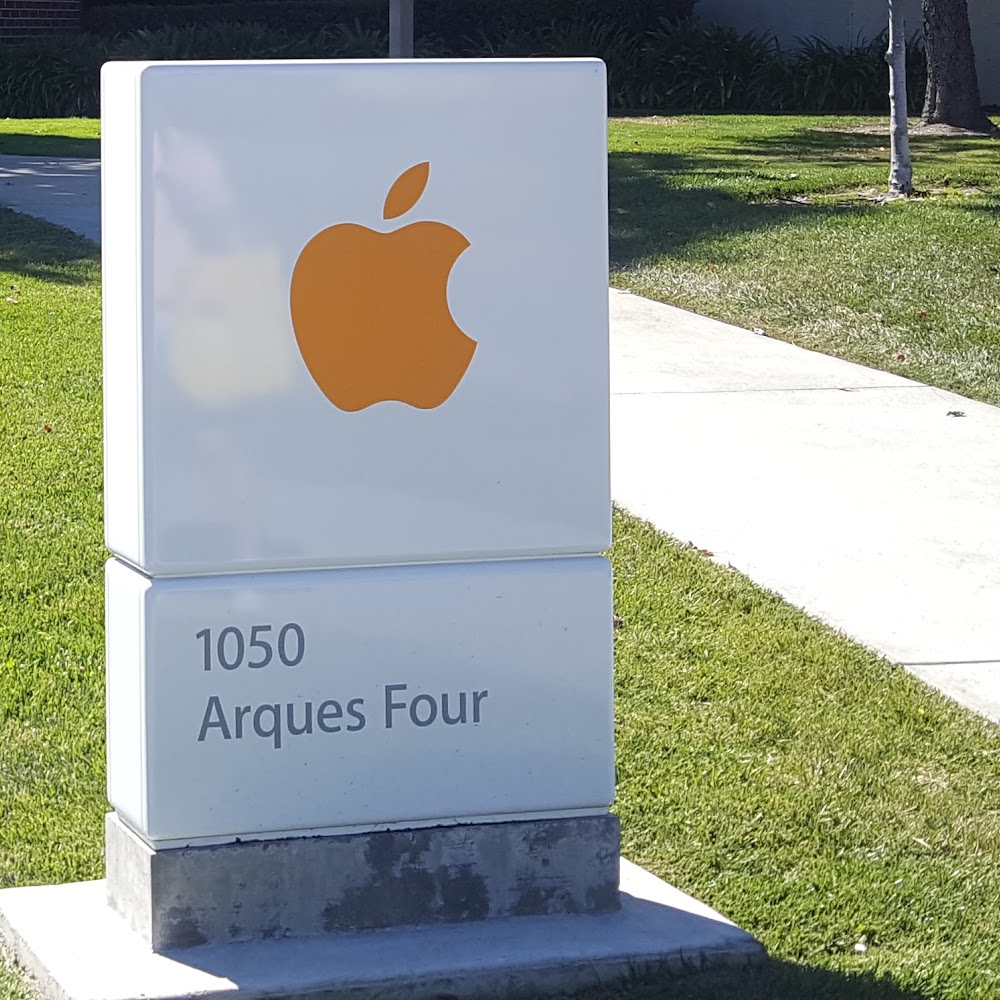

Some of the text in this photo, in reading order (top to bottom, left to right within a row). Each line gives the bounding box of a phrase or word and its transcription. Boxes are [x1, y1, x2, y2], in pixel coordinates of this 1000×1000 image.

[195, 622, 306, 672] 1050
[197, 683, 489, 750] Arques Four
